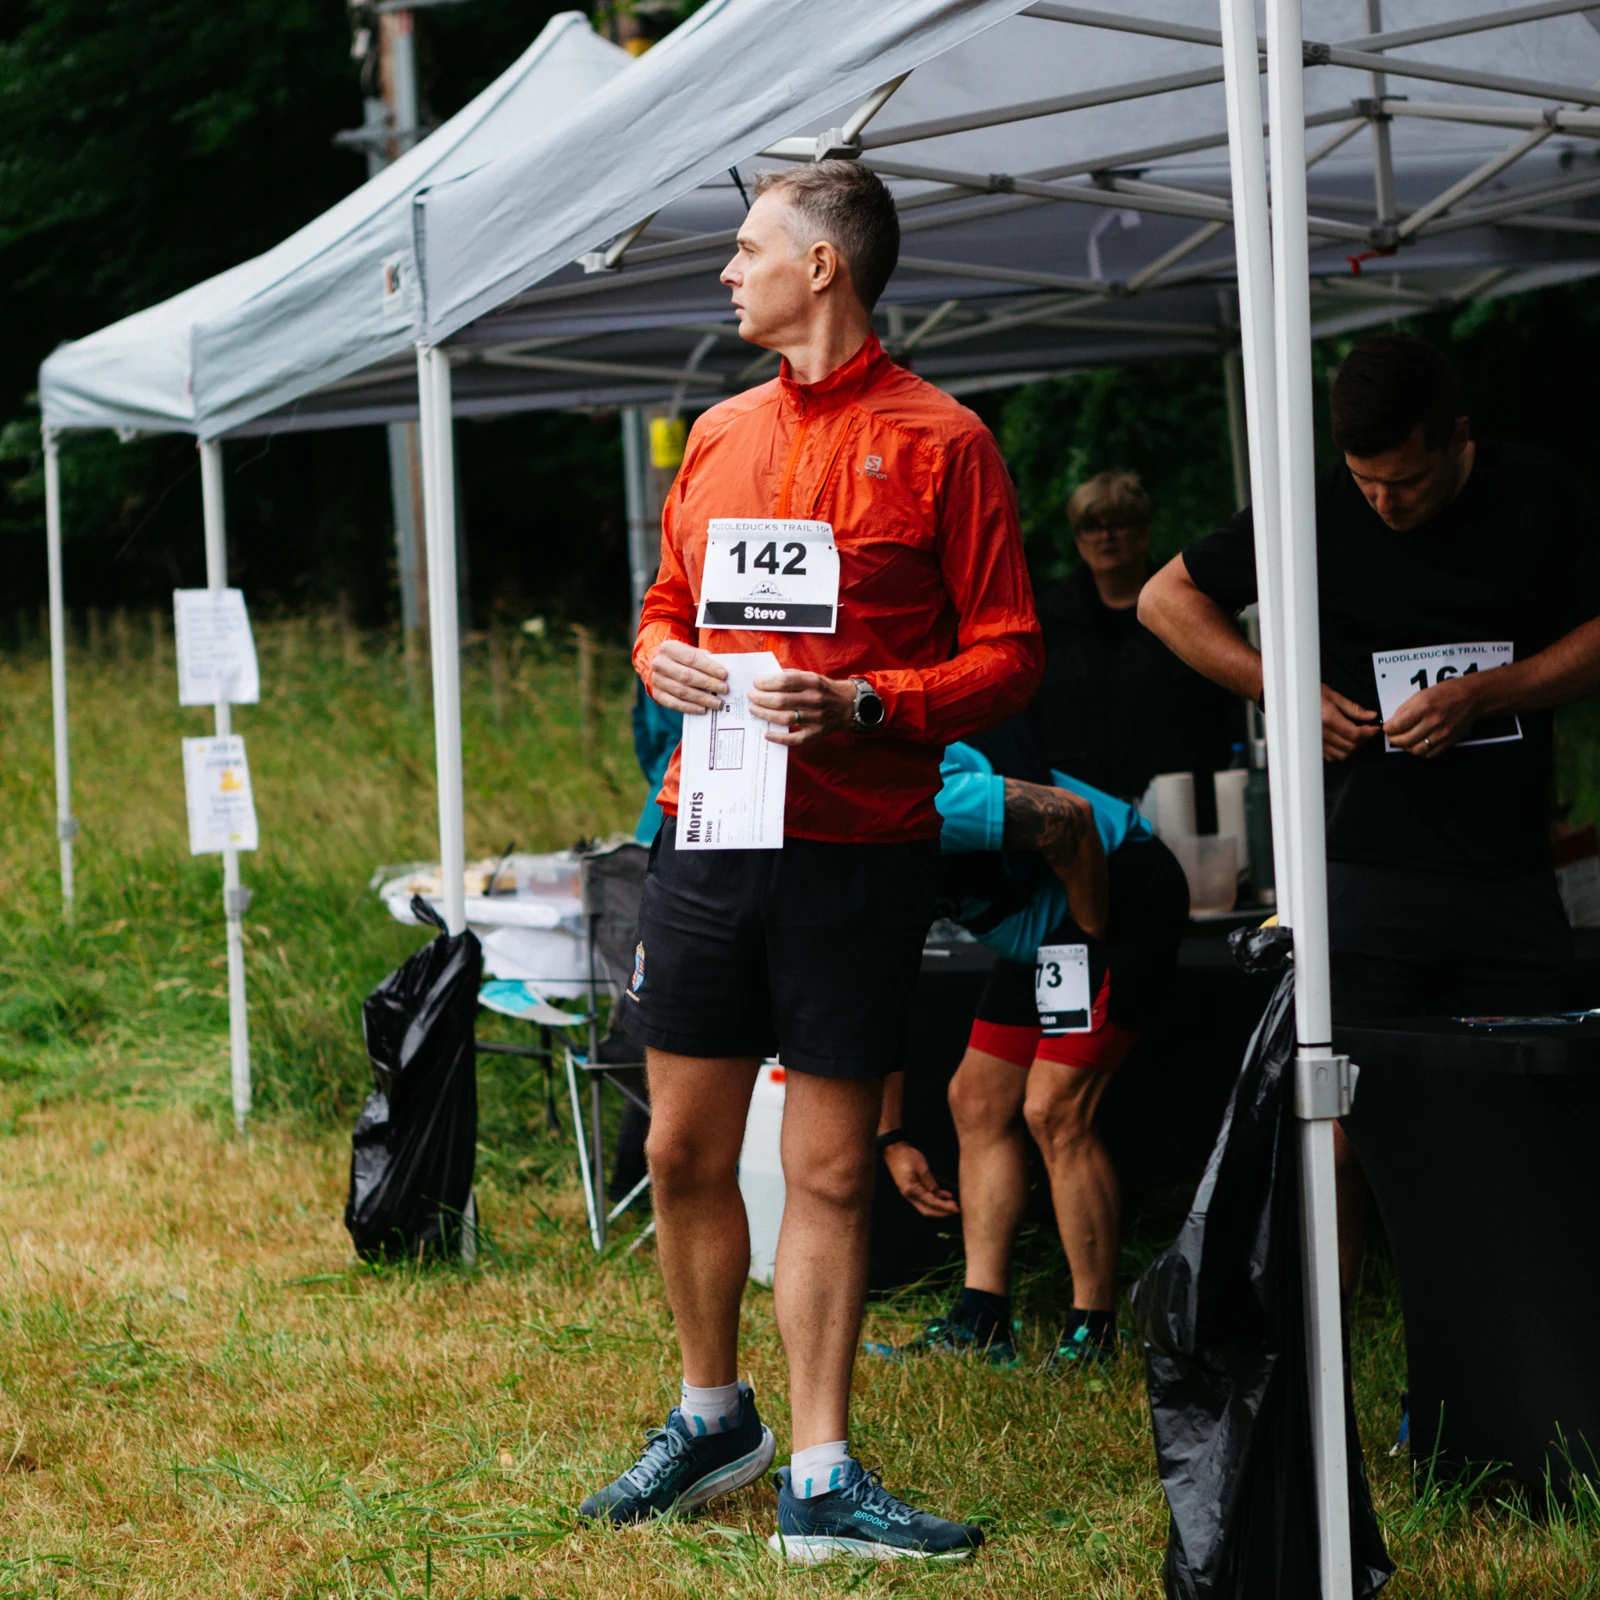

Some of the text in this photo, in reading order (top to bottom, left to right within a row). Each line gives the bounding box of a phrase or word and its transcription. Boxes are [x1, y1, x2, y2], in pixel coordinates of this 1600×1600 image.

[712, 523, 778, 532] PUDDLEDUCKS
[783, 524, 812, 532] TRAIL
[729, 541, 807, 576] 142
[743, 605, 786, 620] Steve
[1377, 645, 1511, 665] PUDDLEDUCKS TRAIL 10K
[686, 791, 704, 843] Morris
[704, 820, 713, 843] Steve
[852, 1510, 891, 1531] BROOKS
